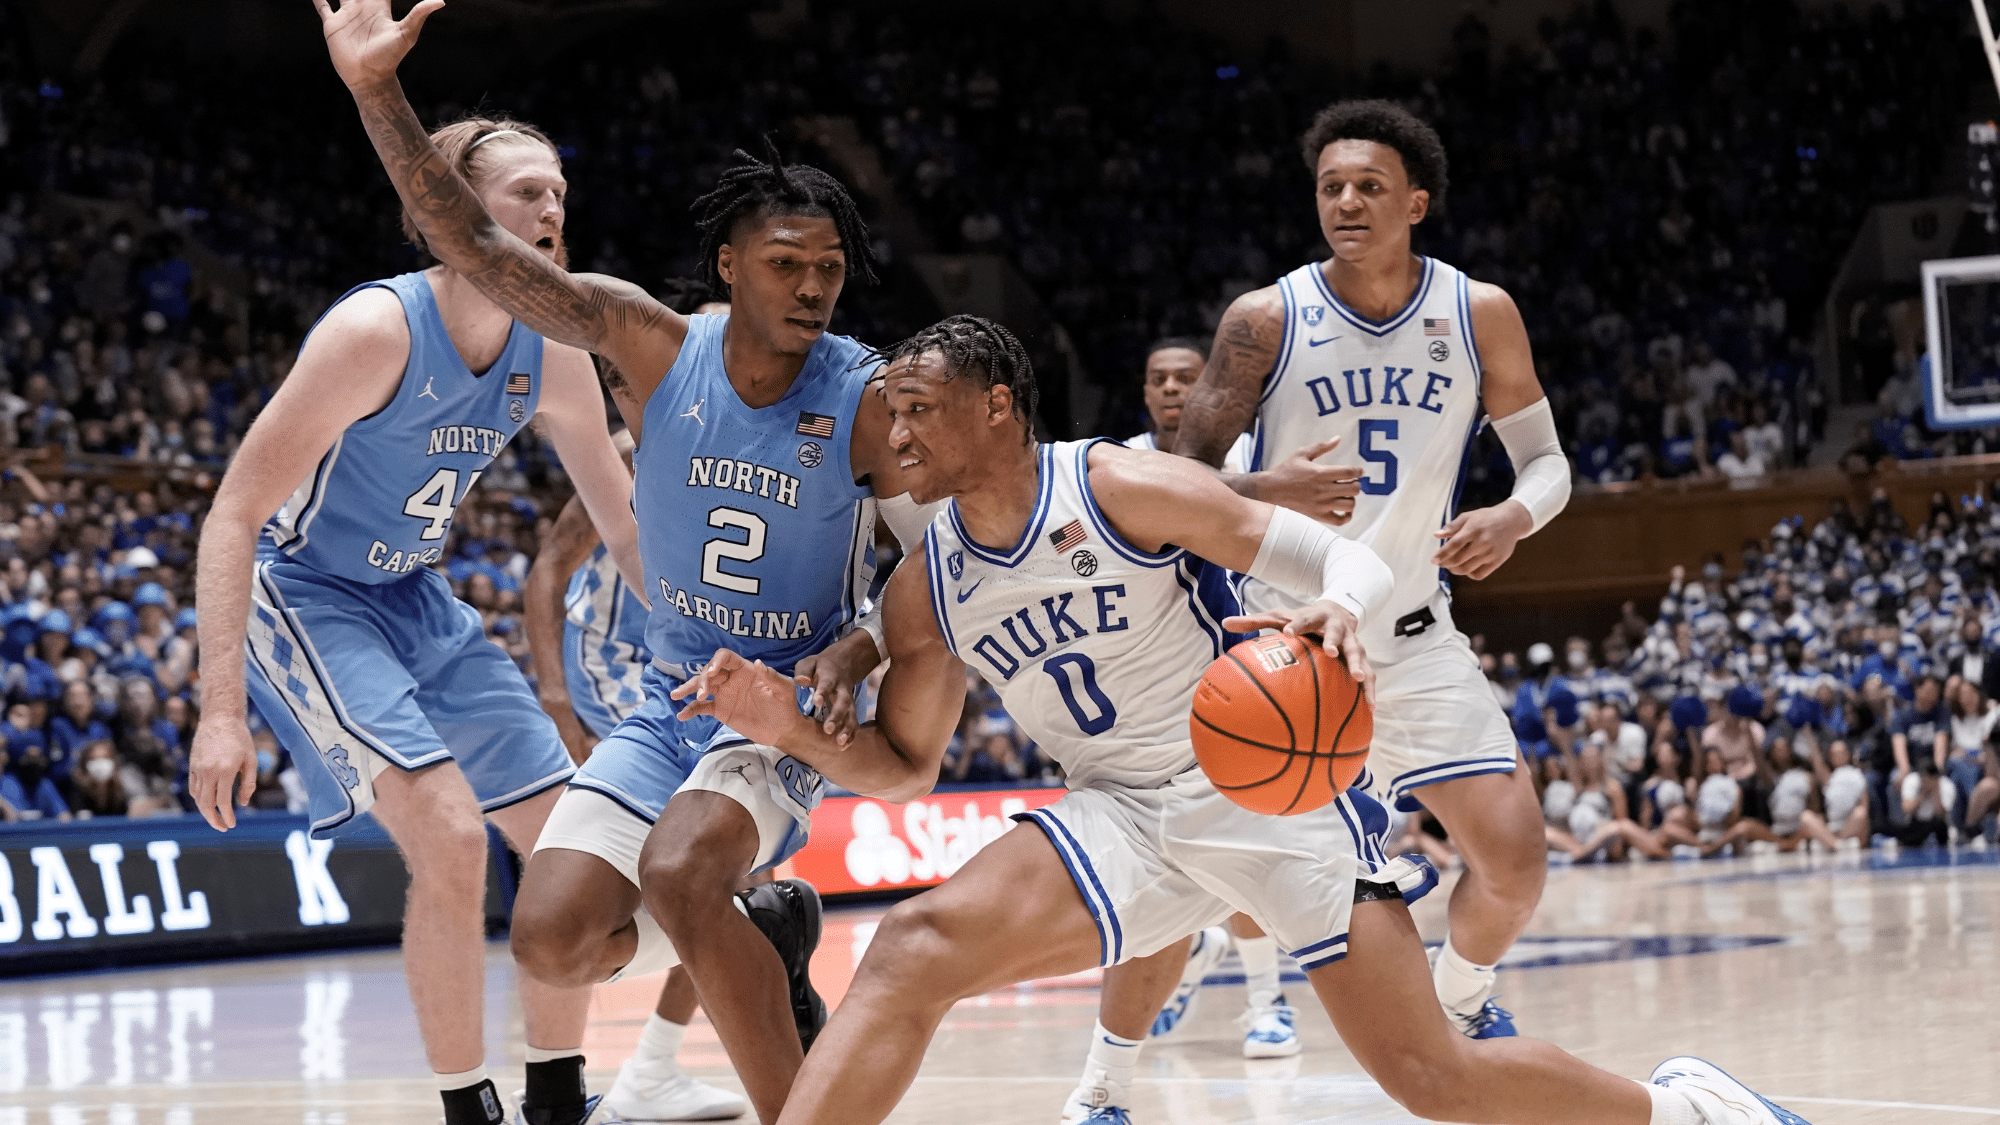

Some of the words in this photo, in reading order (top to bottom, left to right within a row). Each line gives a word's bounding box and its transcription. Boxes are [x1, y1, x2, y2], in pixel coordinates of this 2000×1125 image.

[1305, 366, 1452, 417] DUKE
[427, 425, 506, 459] NORTH
[1358, 419, 1399, 496] 5
[402, 467, 482, 541] 4
[687, 457, 801, 509] NORTH
[701, 505, 768, 596] 2
[659, 577, 813, 640] CAROLINA
[972, 584, 1129, 681] DUKE
[1043, 653, 1117, 736] 0
[286, 830, 350, 926] K
